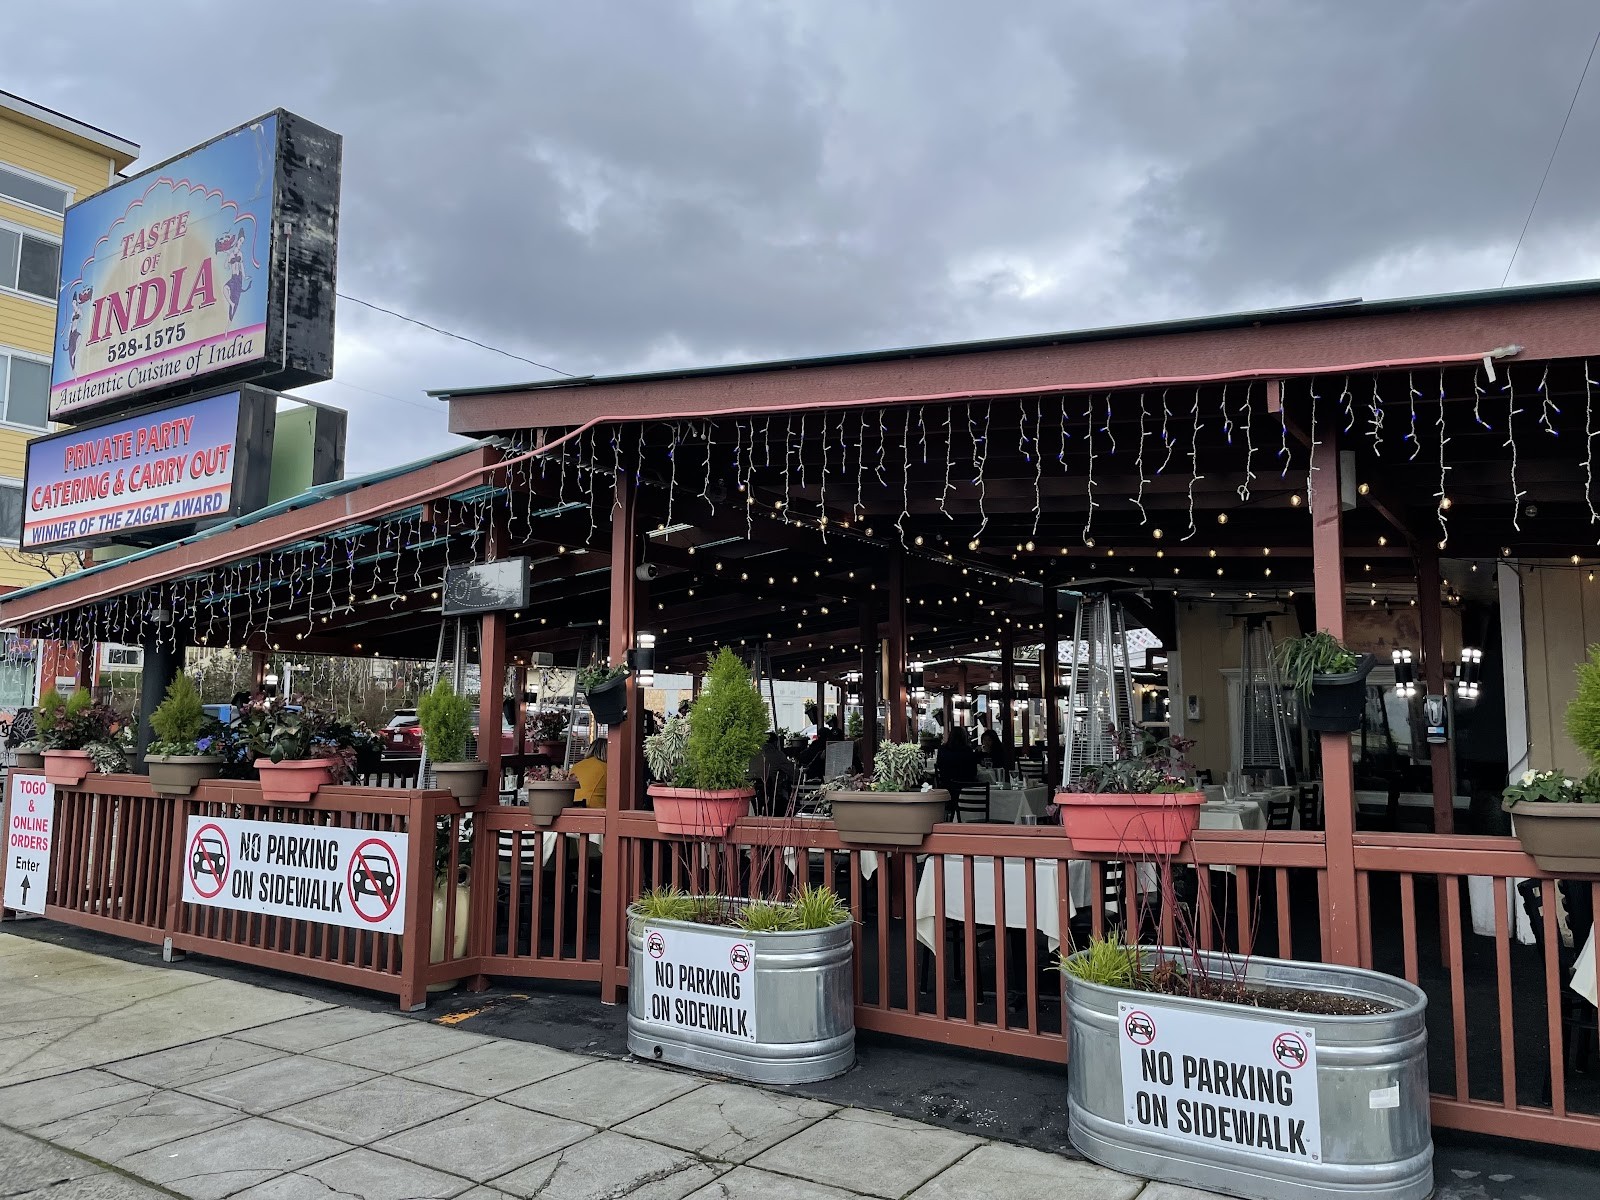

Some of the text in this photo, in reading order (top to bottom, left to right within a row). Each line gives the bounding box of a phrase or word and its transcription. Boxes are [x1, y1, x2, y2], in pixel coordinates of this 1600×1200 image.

[120, 211, 190, 260] TASTE
[140, 252, 161, 275] OF
[86, 257, 217, 346] INDIA
[107, 322, 186, 362] 528-1575
[56, 335, 254, 410] Authentic Cuisine of India
[64, 415, 195, 473] PRIVATE PARTY
[31, 443, 232, 511] CATERING & CARRY OUT
[32, 492, 223, 544] WINNER OF THE ZAGAT AWARD
[20, 780, 46, 796] TOGO
[28, 799, 35, 813] &
[10, 833, 48, 851] ORDERS
[13, 815, 48, 832] ONLINE
[16, 856, 40, 873] Enter
[240, 831, 338, 872] NO PARKING
[231, 869, 344, 914] ON SIDEWALK
[655, 960, 740, 1001] NO PARKING
[652, 993, 748, 1037] ON SIDEWALK
[1141, 1048, 1293, 1107] NO PARKING
[1136, 1091, 1307, 1156] ON SIDEWALK
